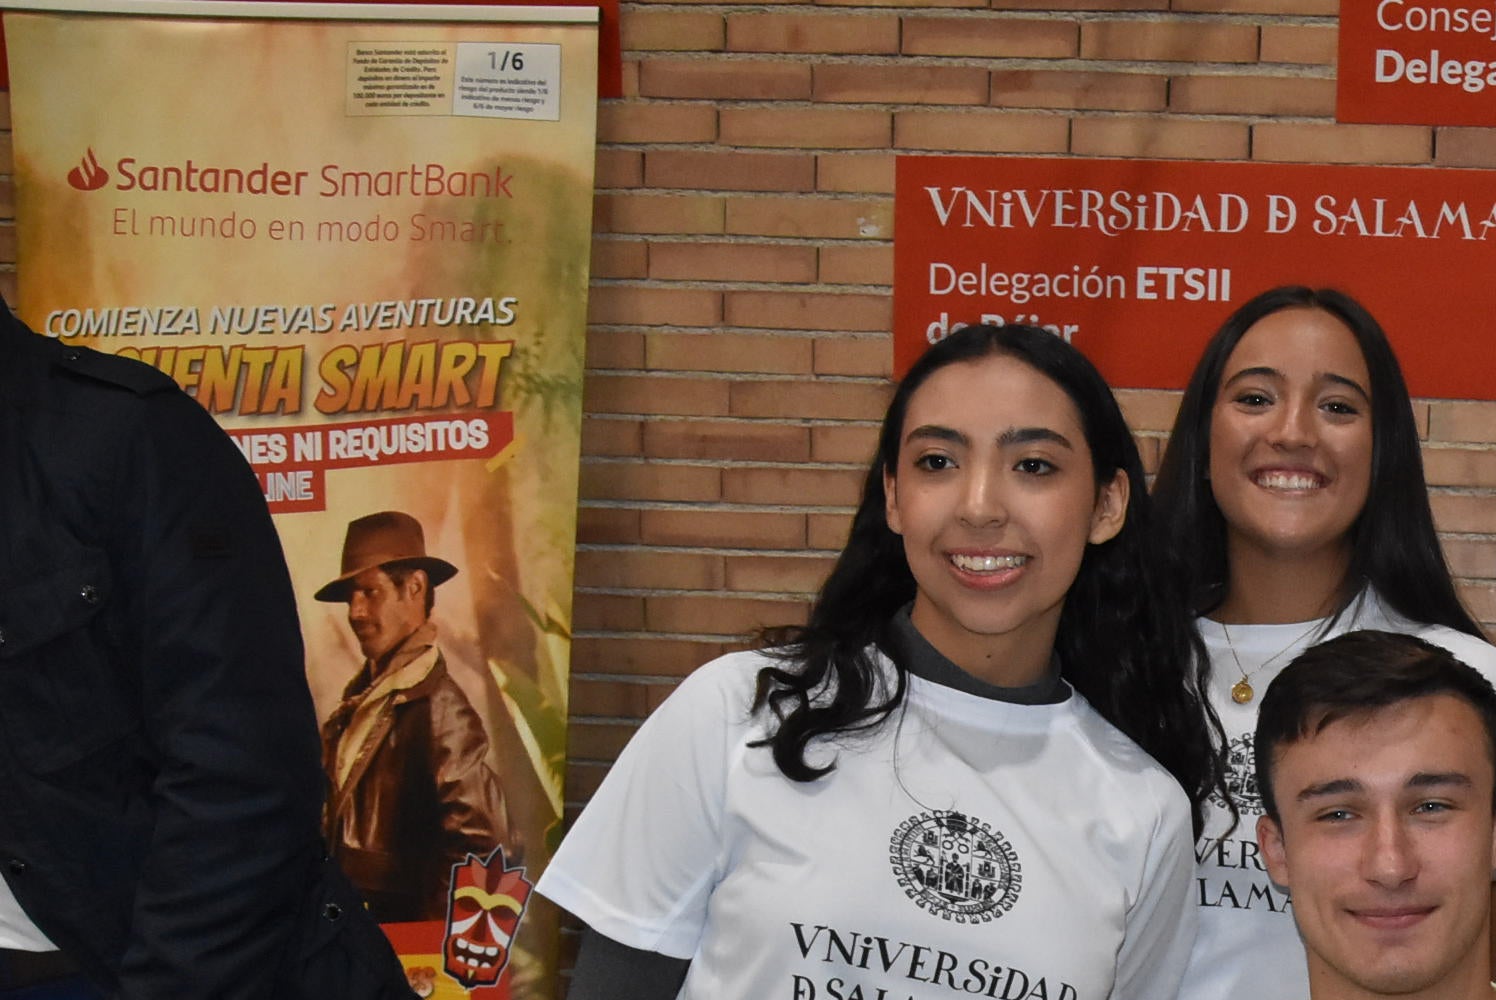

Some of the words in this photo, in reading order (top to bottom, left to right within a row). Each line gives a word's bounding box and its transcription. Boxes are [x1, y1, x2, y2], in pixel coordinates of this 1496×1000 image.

[116, 158, 308, 197] Santander
[319, 164, 514, 200] SmartBank
[113, 208, 139, 236] El
[151, 212, 256, 240] mundo
[269, 219, 304, 242] en
[318, 217, 400, 243] modo
[929, 262, 1126, 304] Delegación
[1136, 266, 1231, 302] ETSII
[45, 306, 201, 339] COMIENZA
[209, 303, 335, 335] NUEVAS
[340, 297, 517, 332] AVENTURAS
[115, 344, 304, 417] ENTA
[314, 340, 515, 414] SMART
[294, 431, 322, 463] NI
[329, 418, 489, 460] REQUISITOS
